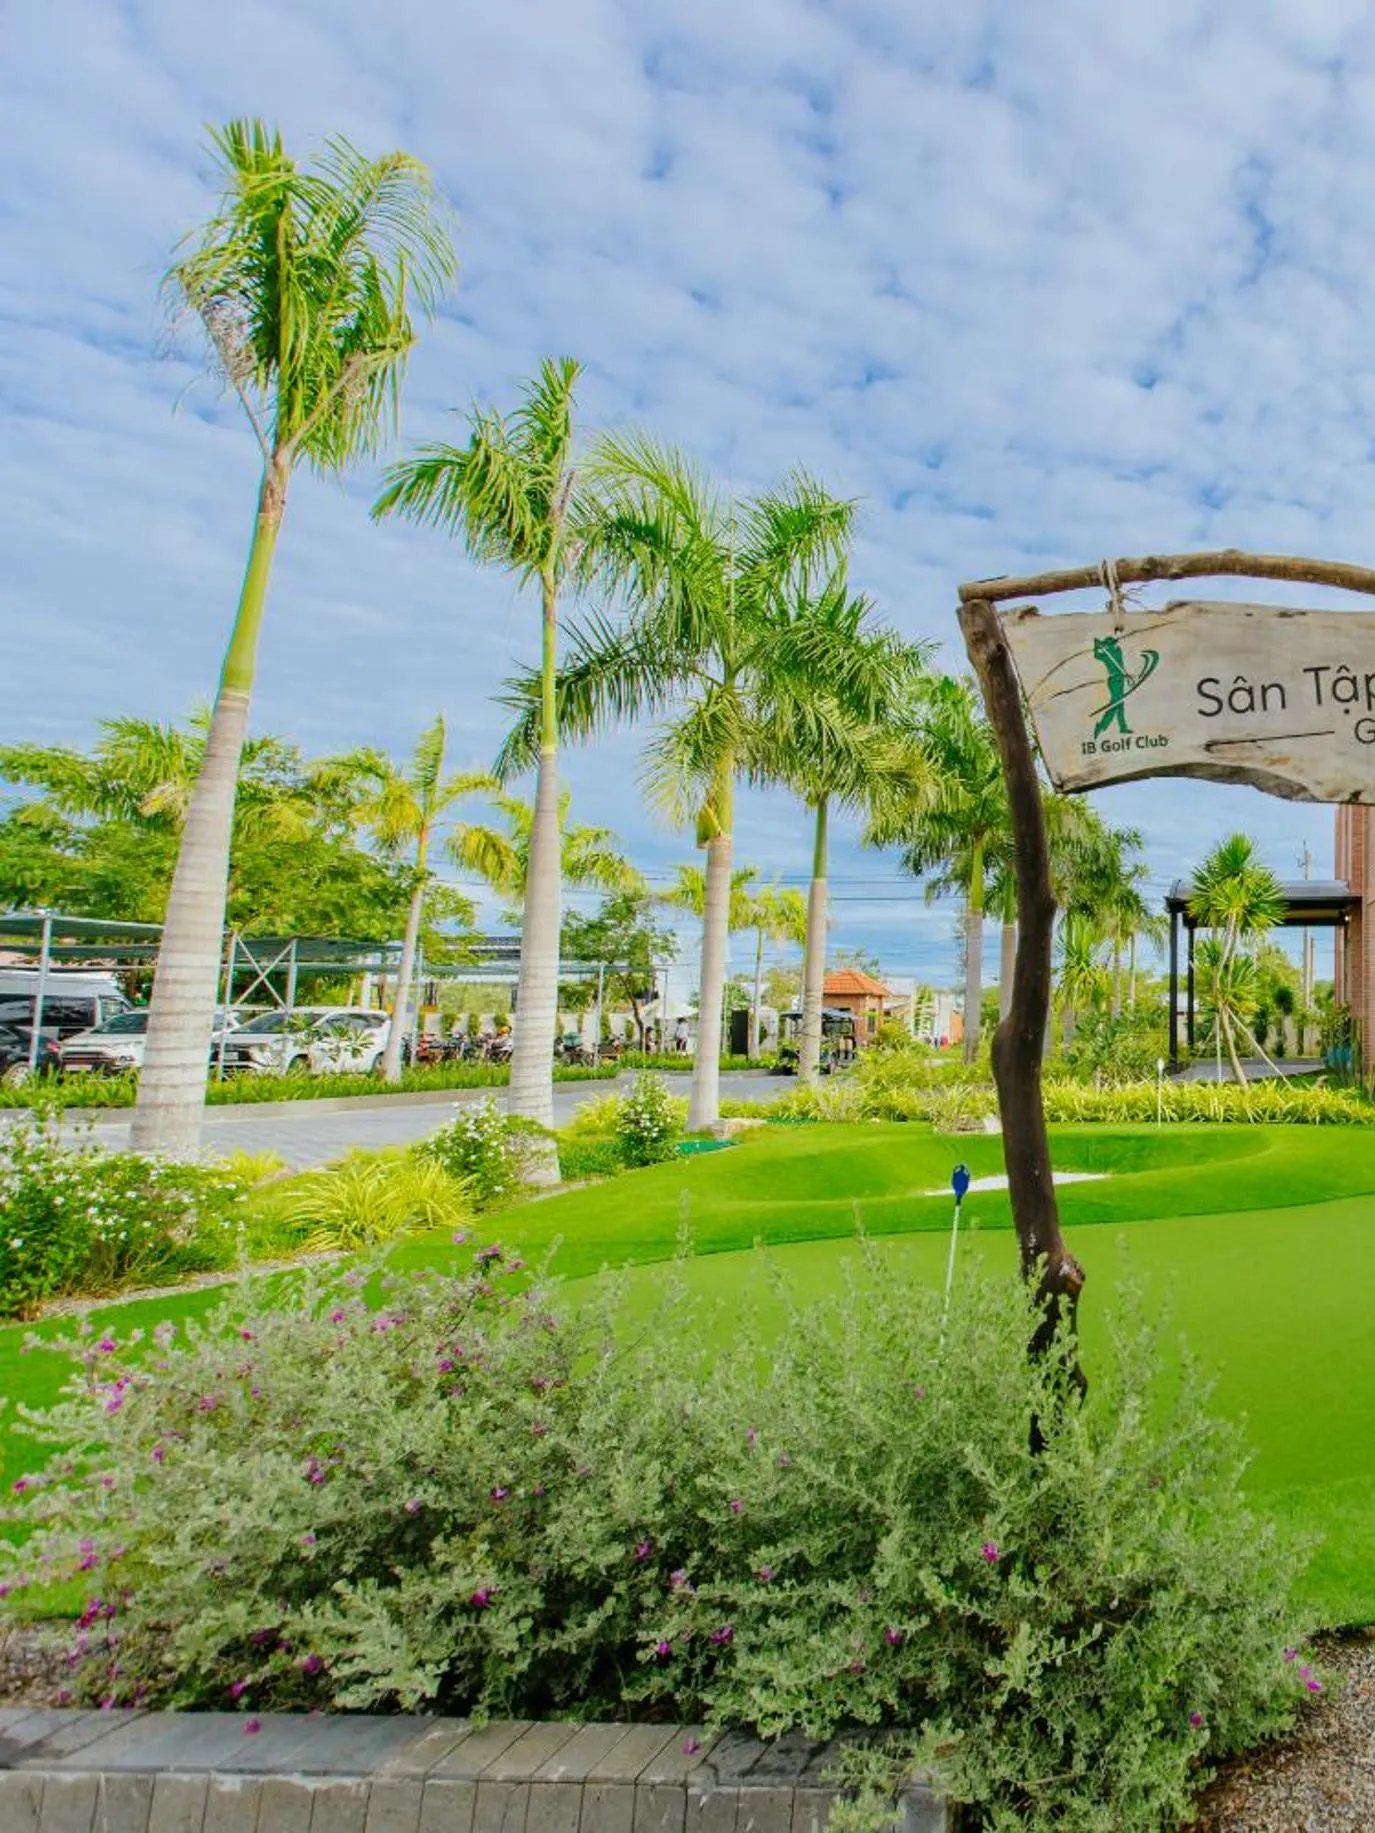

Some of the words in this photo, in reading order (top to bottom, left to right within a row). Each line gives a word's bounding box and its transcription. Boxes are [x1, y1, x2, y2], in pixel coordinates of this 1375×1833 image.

[1196, 675, 1286, 717] Sân
[1101, 737, 1131, 752] Golf
[1135, 734, 1169, 749] Club
